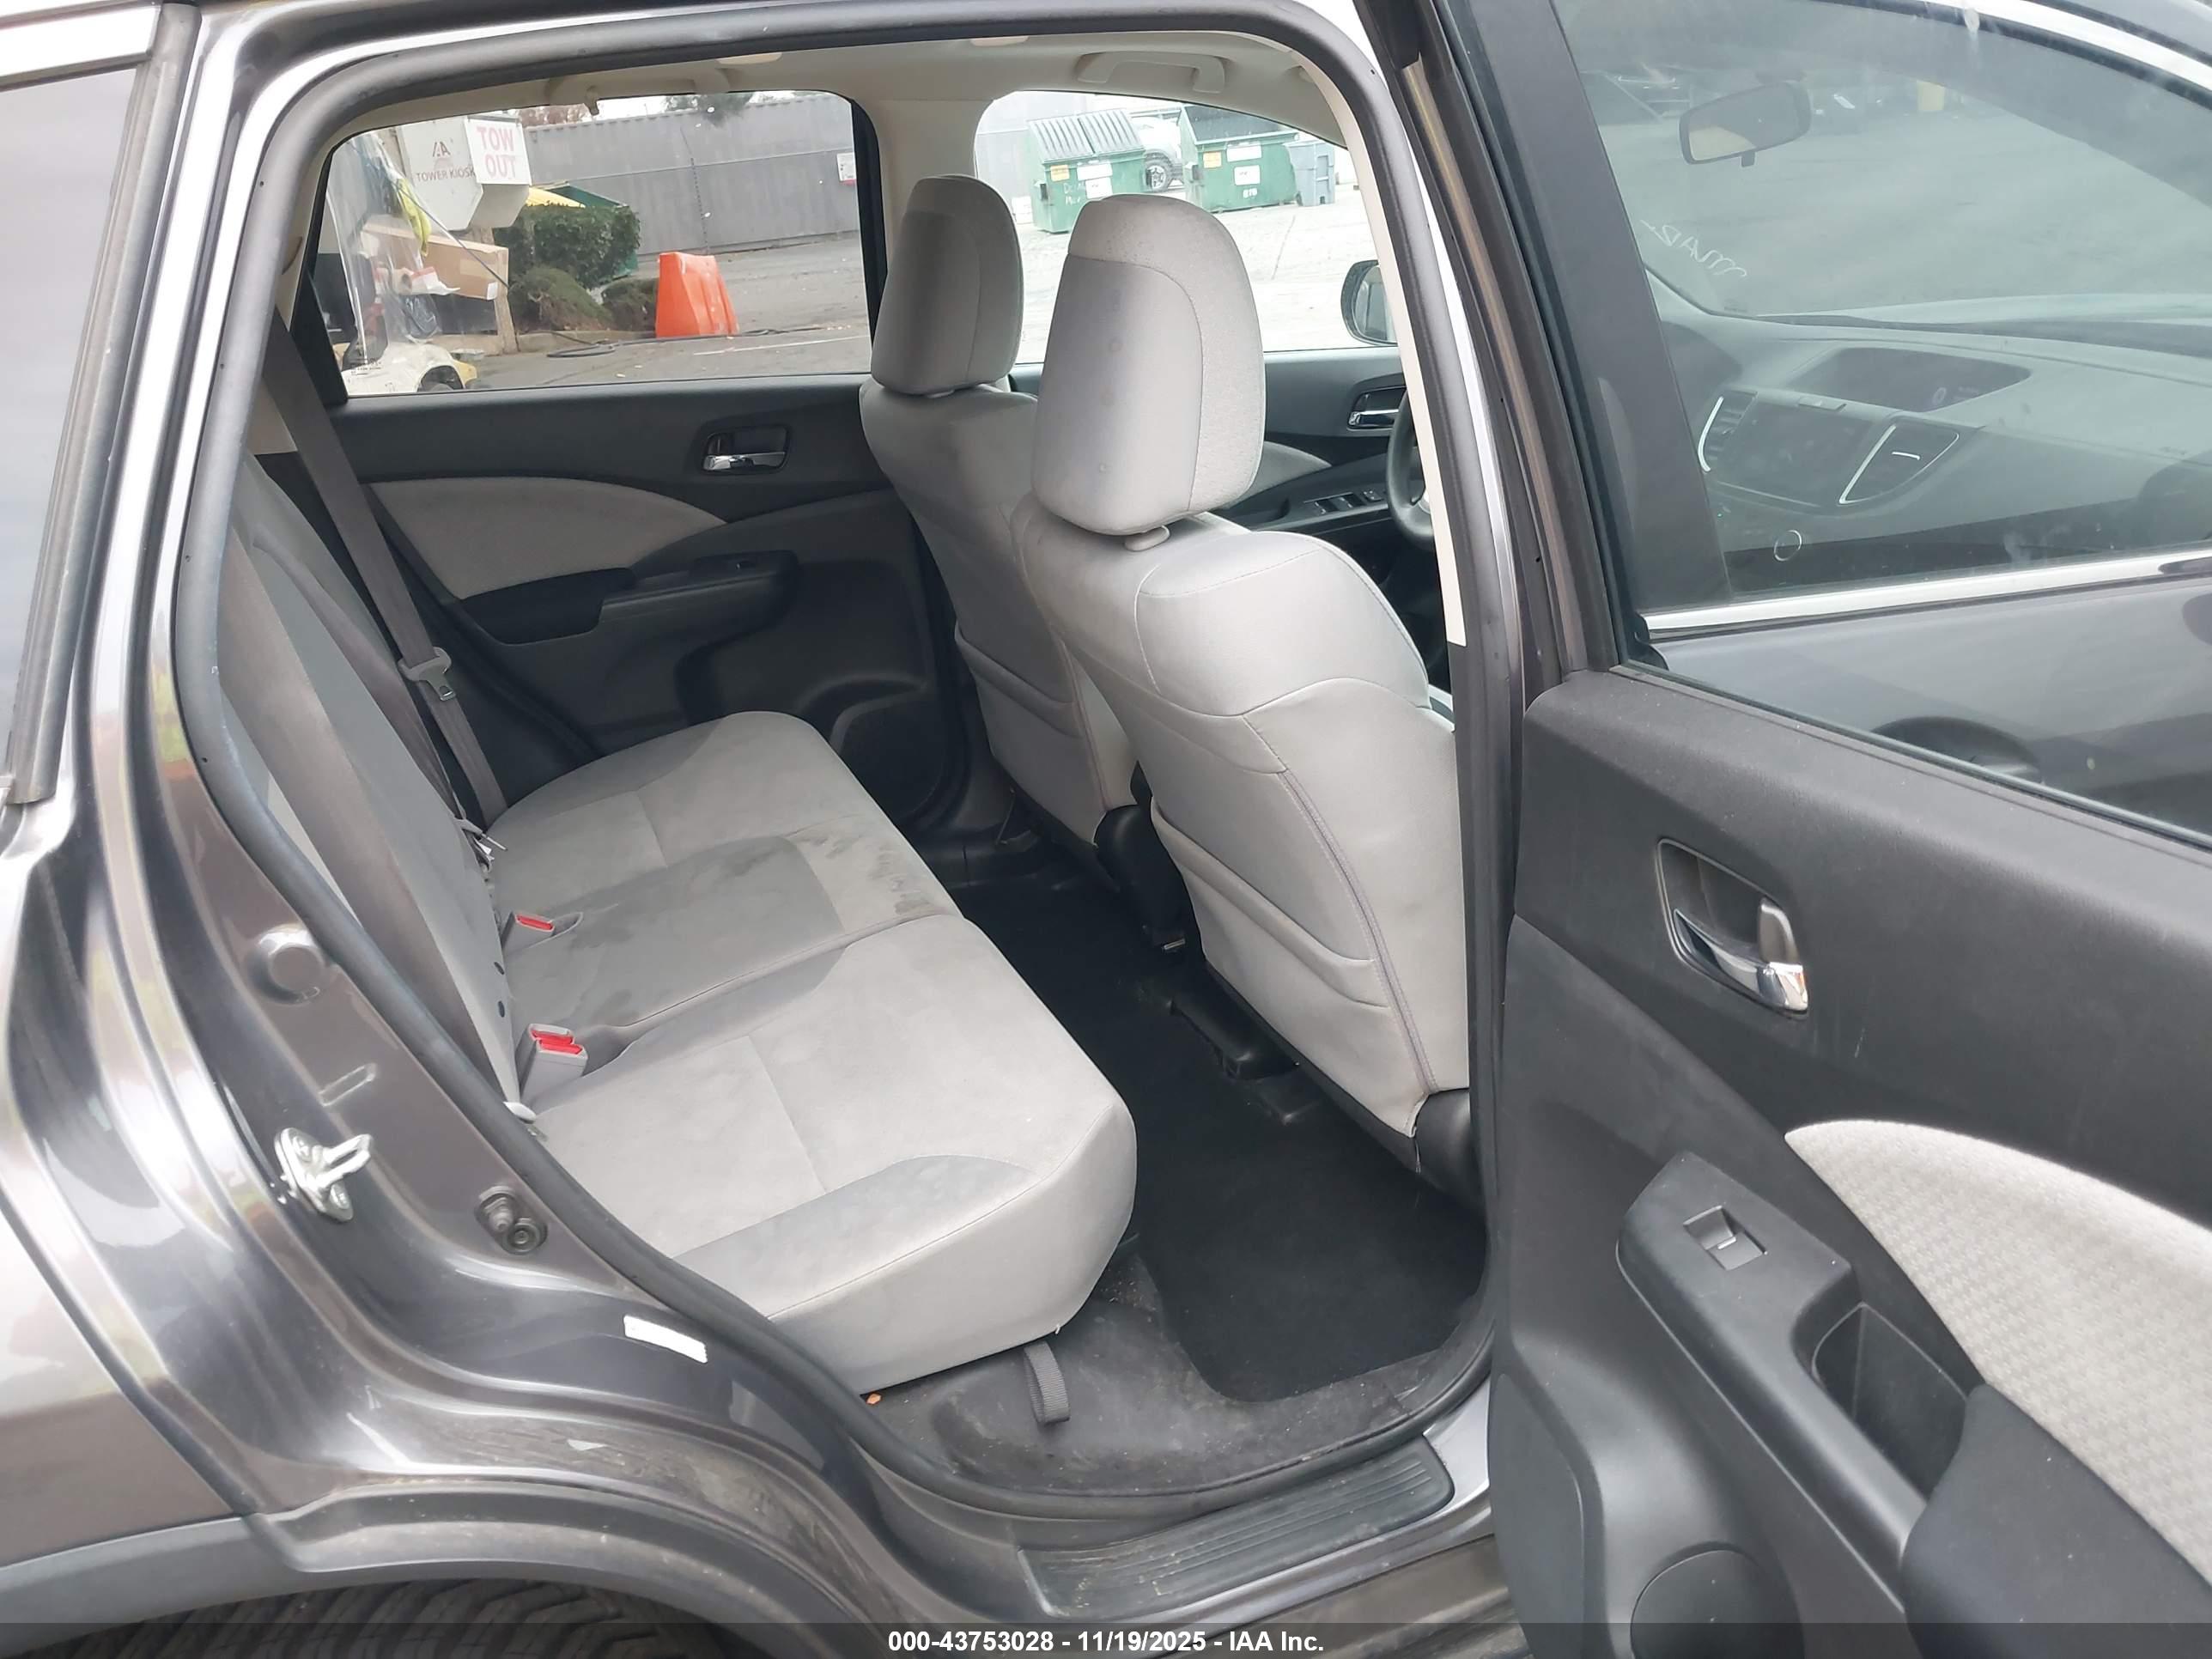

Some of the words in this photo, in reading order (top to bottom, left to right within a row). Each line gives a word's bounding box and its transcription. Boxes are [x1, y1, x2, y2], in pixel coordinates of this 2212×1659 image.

[476, 125, 514, 151] TOW
[416, 170, 447, 182] TOWER
[484, 154, 517, 179] OUT
